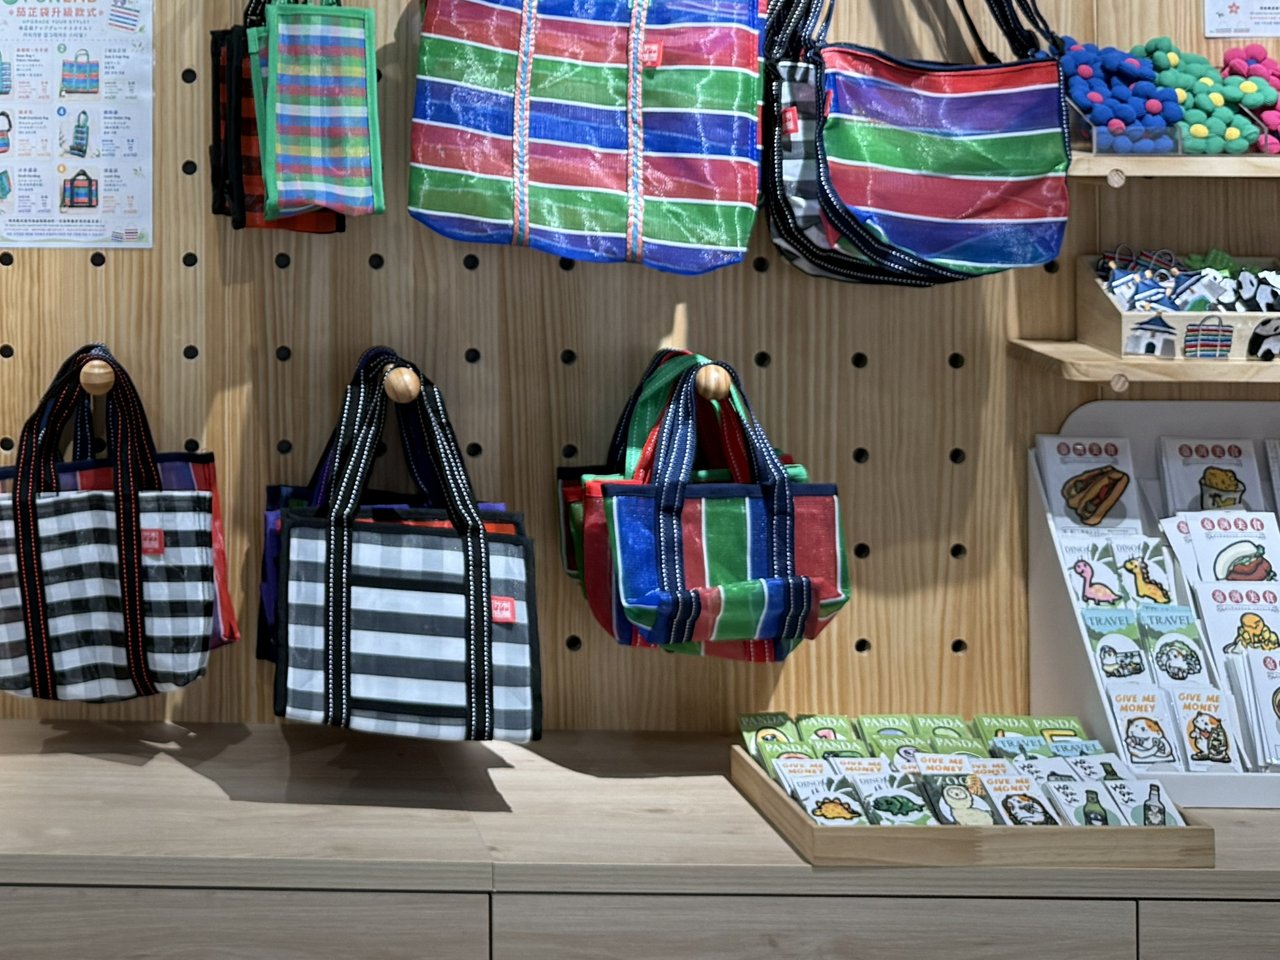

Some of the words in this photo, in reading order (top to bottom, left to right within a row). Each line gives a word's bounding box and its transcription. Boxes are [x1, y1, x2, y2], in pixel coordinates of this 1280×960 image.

[16, 7, 97, 17] 茄芷袋升級款式
[1088, 617, 1130, 626] TRAVEL
[1147, 616, 1191, 626] TRAVEL
[1115, 694, 1137, 703] GIVE
[1142, 695, 1156, 703] ME
[1178, 693, 1201, 702] GIVE
[1206, 694, 1220, 703] ME
[1119, 704, 1156, 713] MONEY
[1183, 703, 1219, 712] MONEY
[801, 717, 848, 728] PANDA
[863, 717, 910, 727] PANDA
[918, 718, 964, 728] PANDA
[982, 717, 1029, 728] PANDA
[1033, 719, 1080, 729] PANDA
[765, 742, 812, 753] PANDA
[814, 740, 861, 751] PANDA
[936, 738, 982, 749] PANDA
[1054, 742, 1101, 753] TRAVEL
[993, 784, 1031, 792] MONEY
